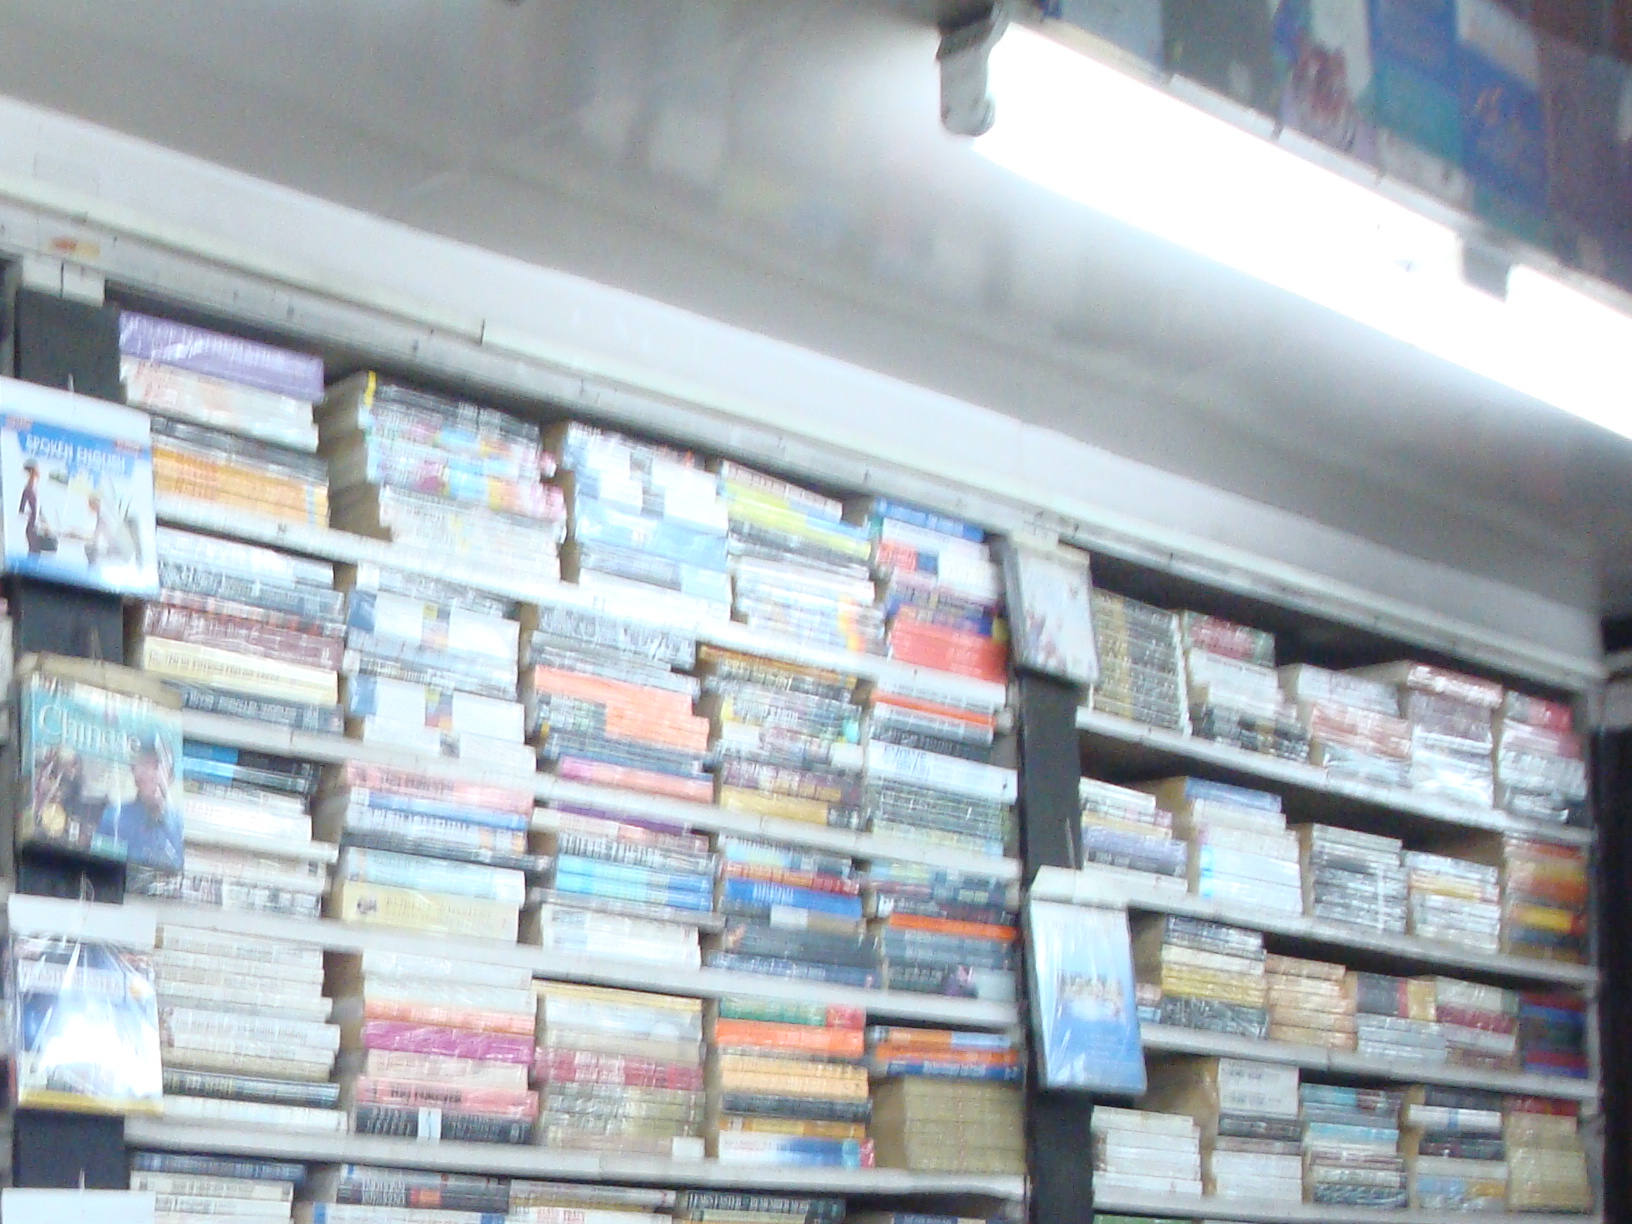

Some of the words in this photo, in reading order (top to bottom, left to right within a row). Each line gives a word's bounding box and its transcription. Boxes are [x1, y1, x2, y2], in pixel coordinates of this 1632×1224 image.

[26, 434, 73, 460] SPOKEN
[76, 445, 125, 471] ENGLISH
[39, 704, 142, 757] Chinese
